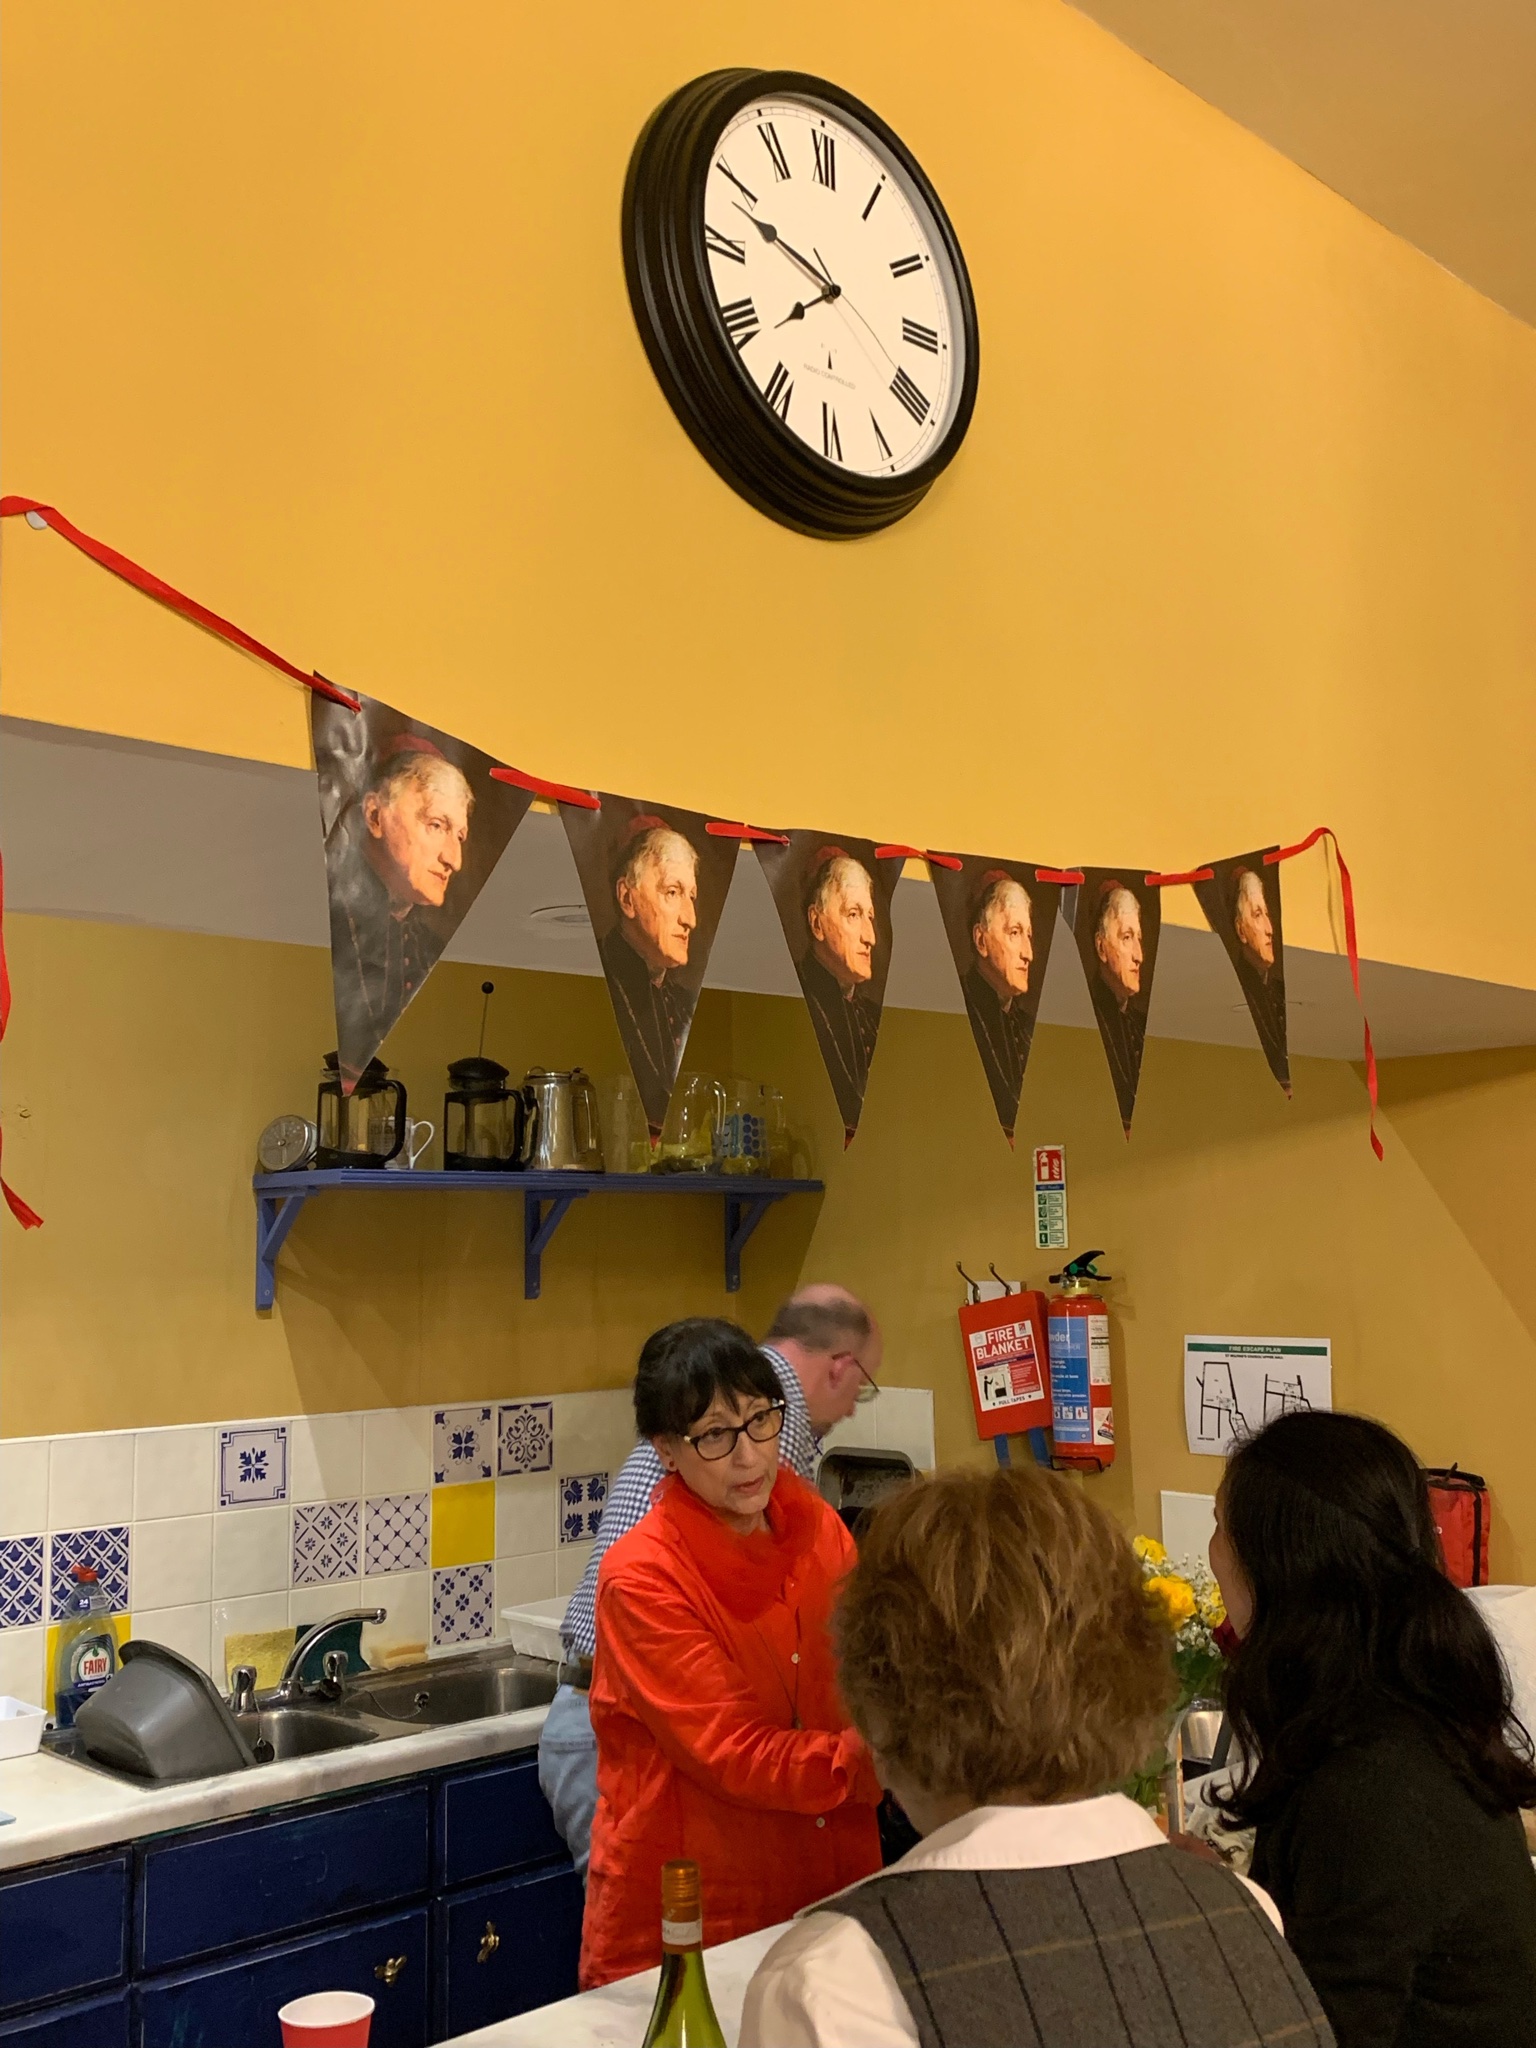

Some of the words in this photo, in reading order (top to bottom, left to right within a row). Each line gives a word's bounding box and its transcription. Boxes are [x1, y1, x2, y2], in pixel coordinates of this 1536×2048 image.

[757, 121, 792, 183] XI
[811, 127, 836, 192] XII
[987, 1327, 1014, 1344] FIRE
[976, 1337, 1029, 1360] BLANKET
[83, 1658, 107, 1675] FAIRY
